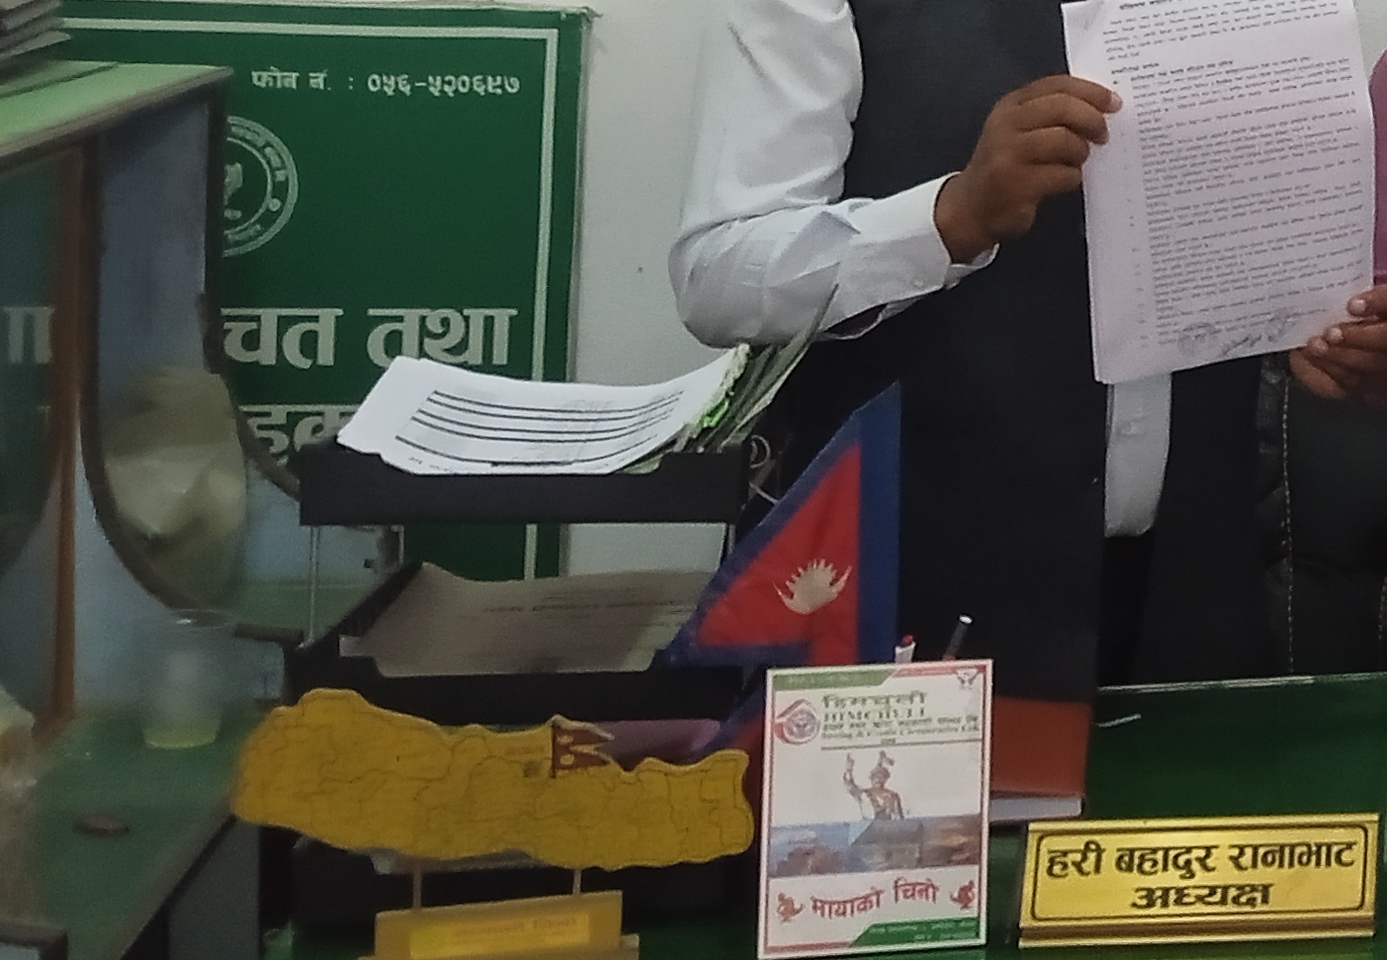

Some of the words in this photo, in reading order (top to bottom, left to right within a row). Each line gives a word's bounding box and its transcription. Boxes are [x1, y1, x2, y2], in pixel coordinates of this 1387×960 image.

[251, 66, 299, 90] फोन
[367, 74, 521, 97] ०५६-५२०६९७
[220, 306, 344, 370] चत
[366, 307, 519, 367] तथा
[1046, 841, 1106, 878] हरी
[1115, 845, 1220, 881] बहादुर
[1228, 841, 1358, 871] रानाभाट
[810, 886, 886, 920] मायाको
